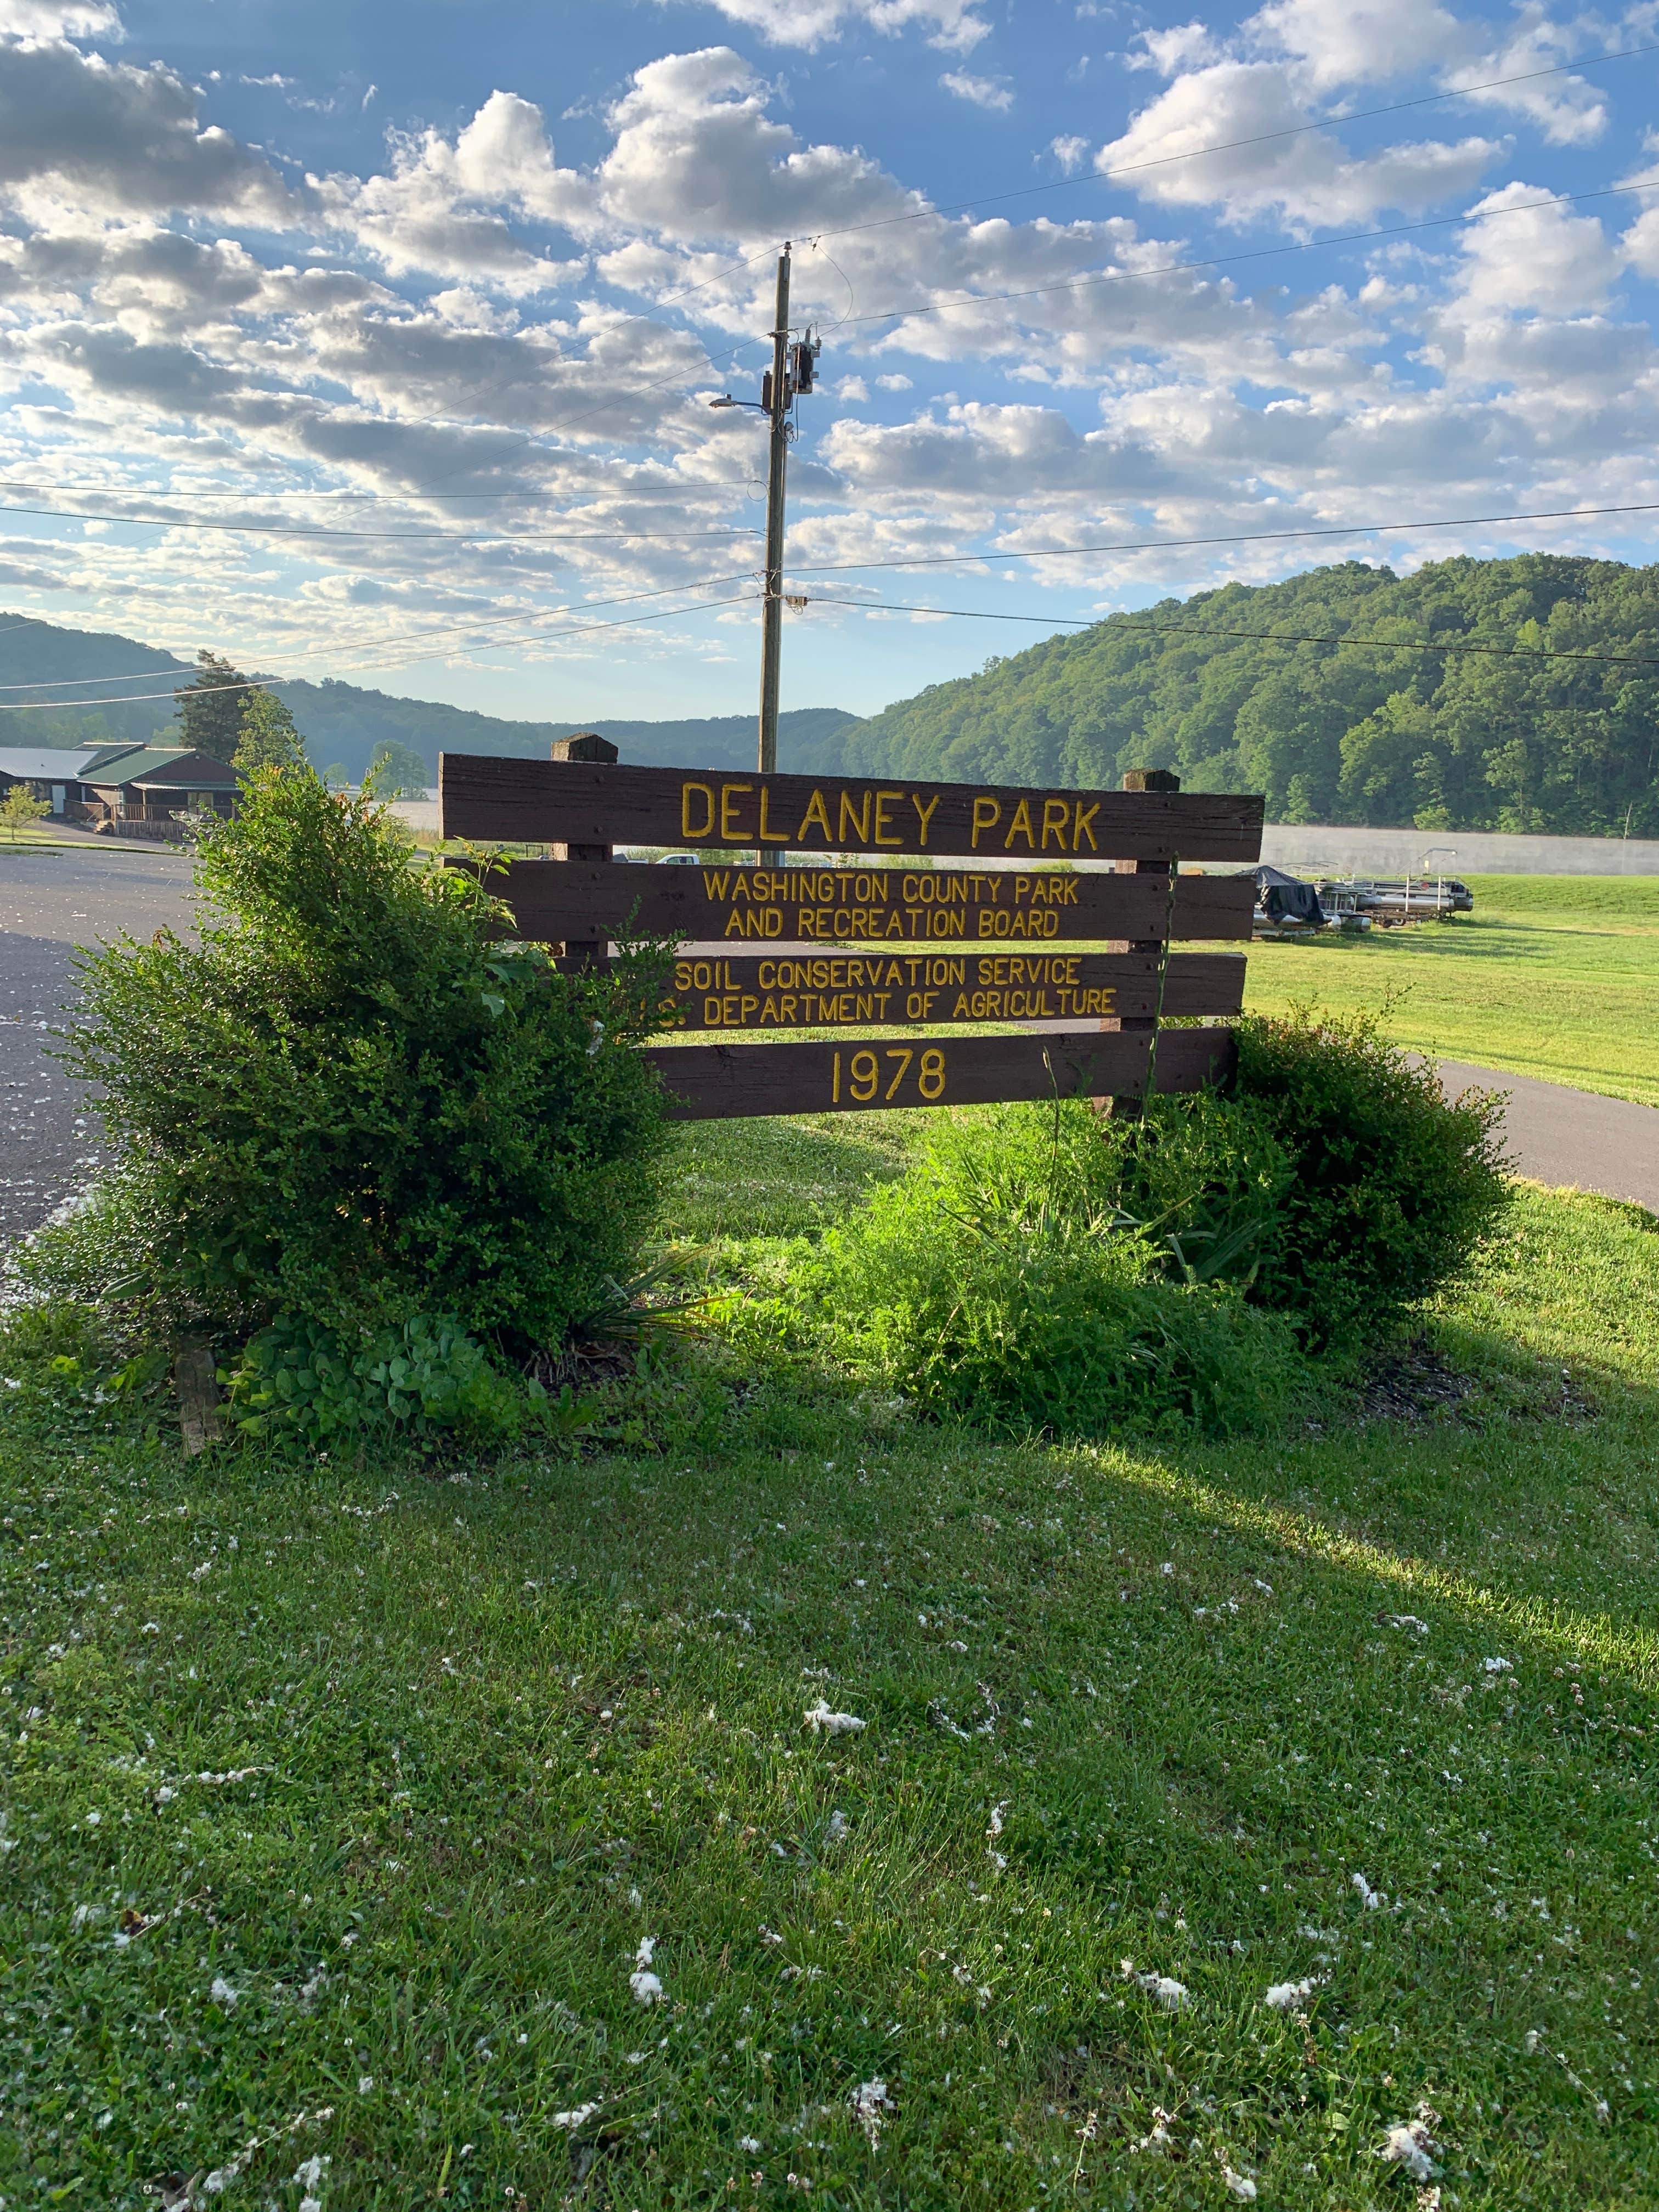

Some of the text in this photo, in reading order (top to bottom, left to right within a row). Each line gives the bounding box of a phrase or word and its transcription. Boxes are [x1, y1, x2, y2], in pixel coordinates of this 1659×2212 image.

[682, 782, 1100, 850] DELANEY PARK
[703, 871, 1079, 905] WASHINGTON COUNTY PARK
[724, 907, 1059, 938] AND RECREATION BOARD
[675, 957, 1082, 990] SOIL CONSERVATION SERVICE
[704, 992, 891, 1025] DEPARTMENT
[907, 991, 940, 1018] OF
[952, 988, 1116, 1018] AGRICULTURE
[833, 1048, 945, 1102] 1978
